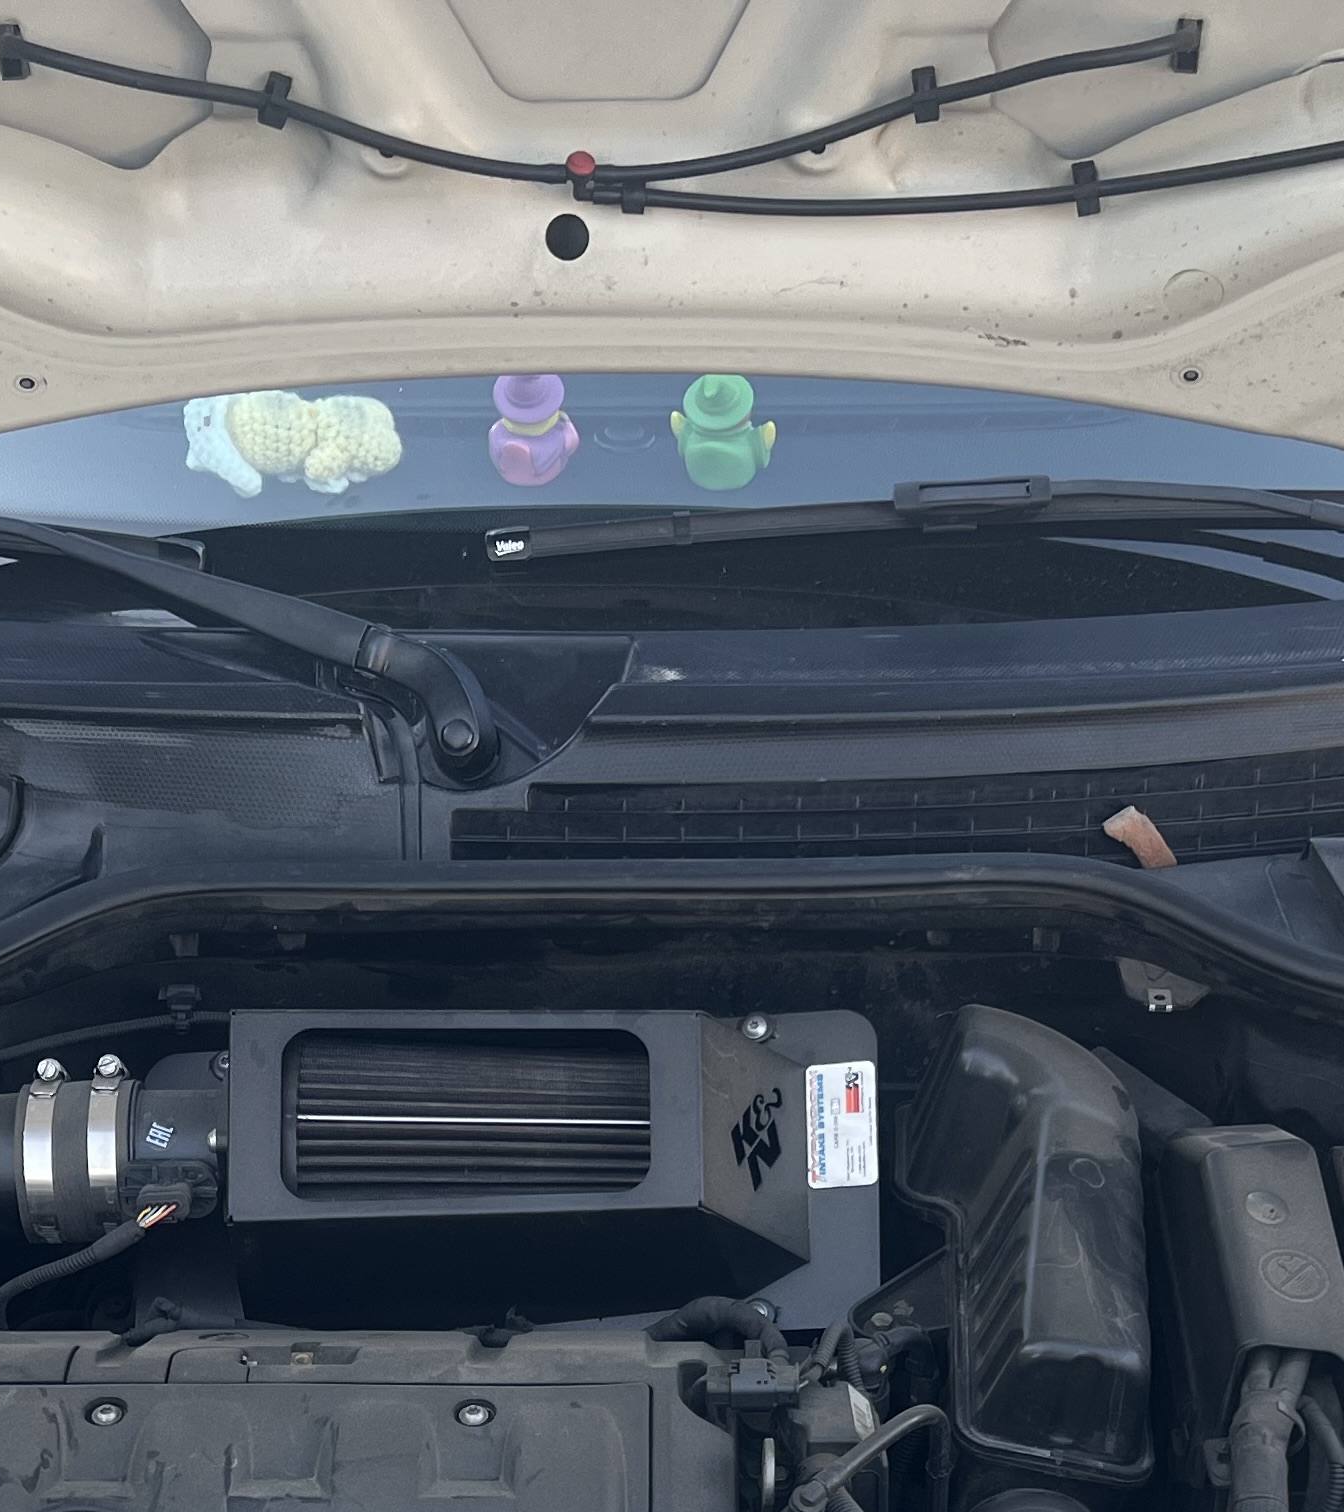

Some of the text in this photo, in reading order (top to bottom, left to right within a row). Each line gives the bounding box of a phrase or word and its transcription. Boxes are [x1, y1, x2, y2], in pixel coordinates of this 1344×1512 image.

[495, 540, 525, 552] Valeo
[730, 1087, 783, 1192] K&N
[816, 1074, 826, 1175] INTAKE SYSTEMS
